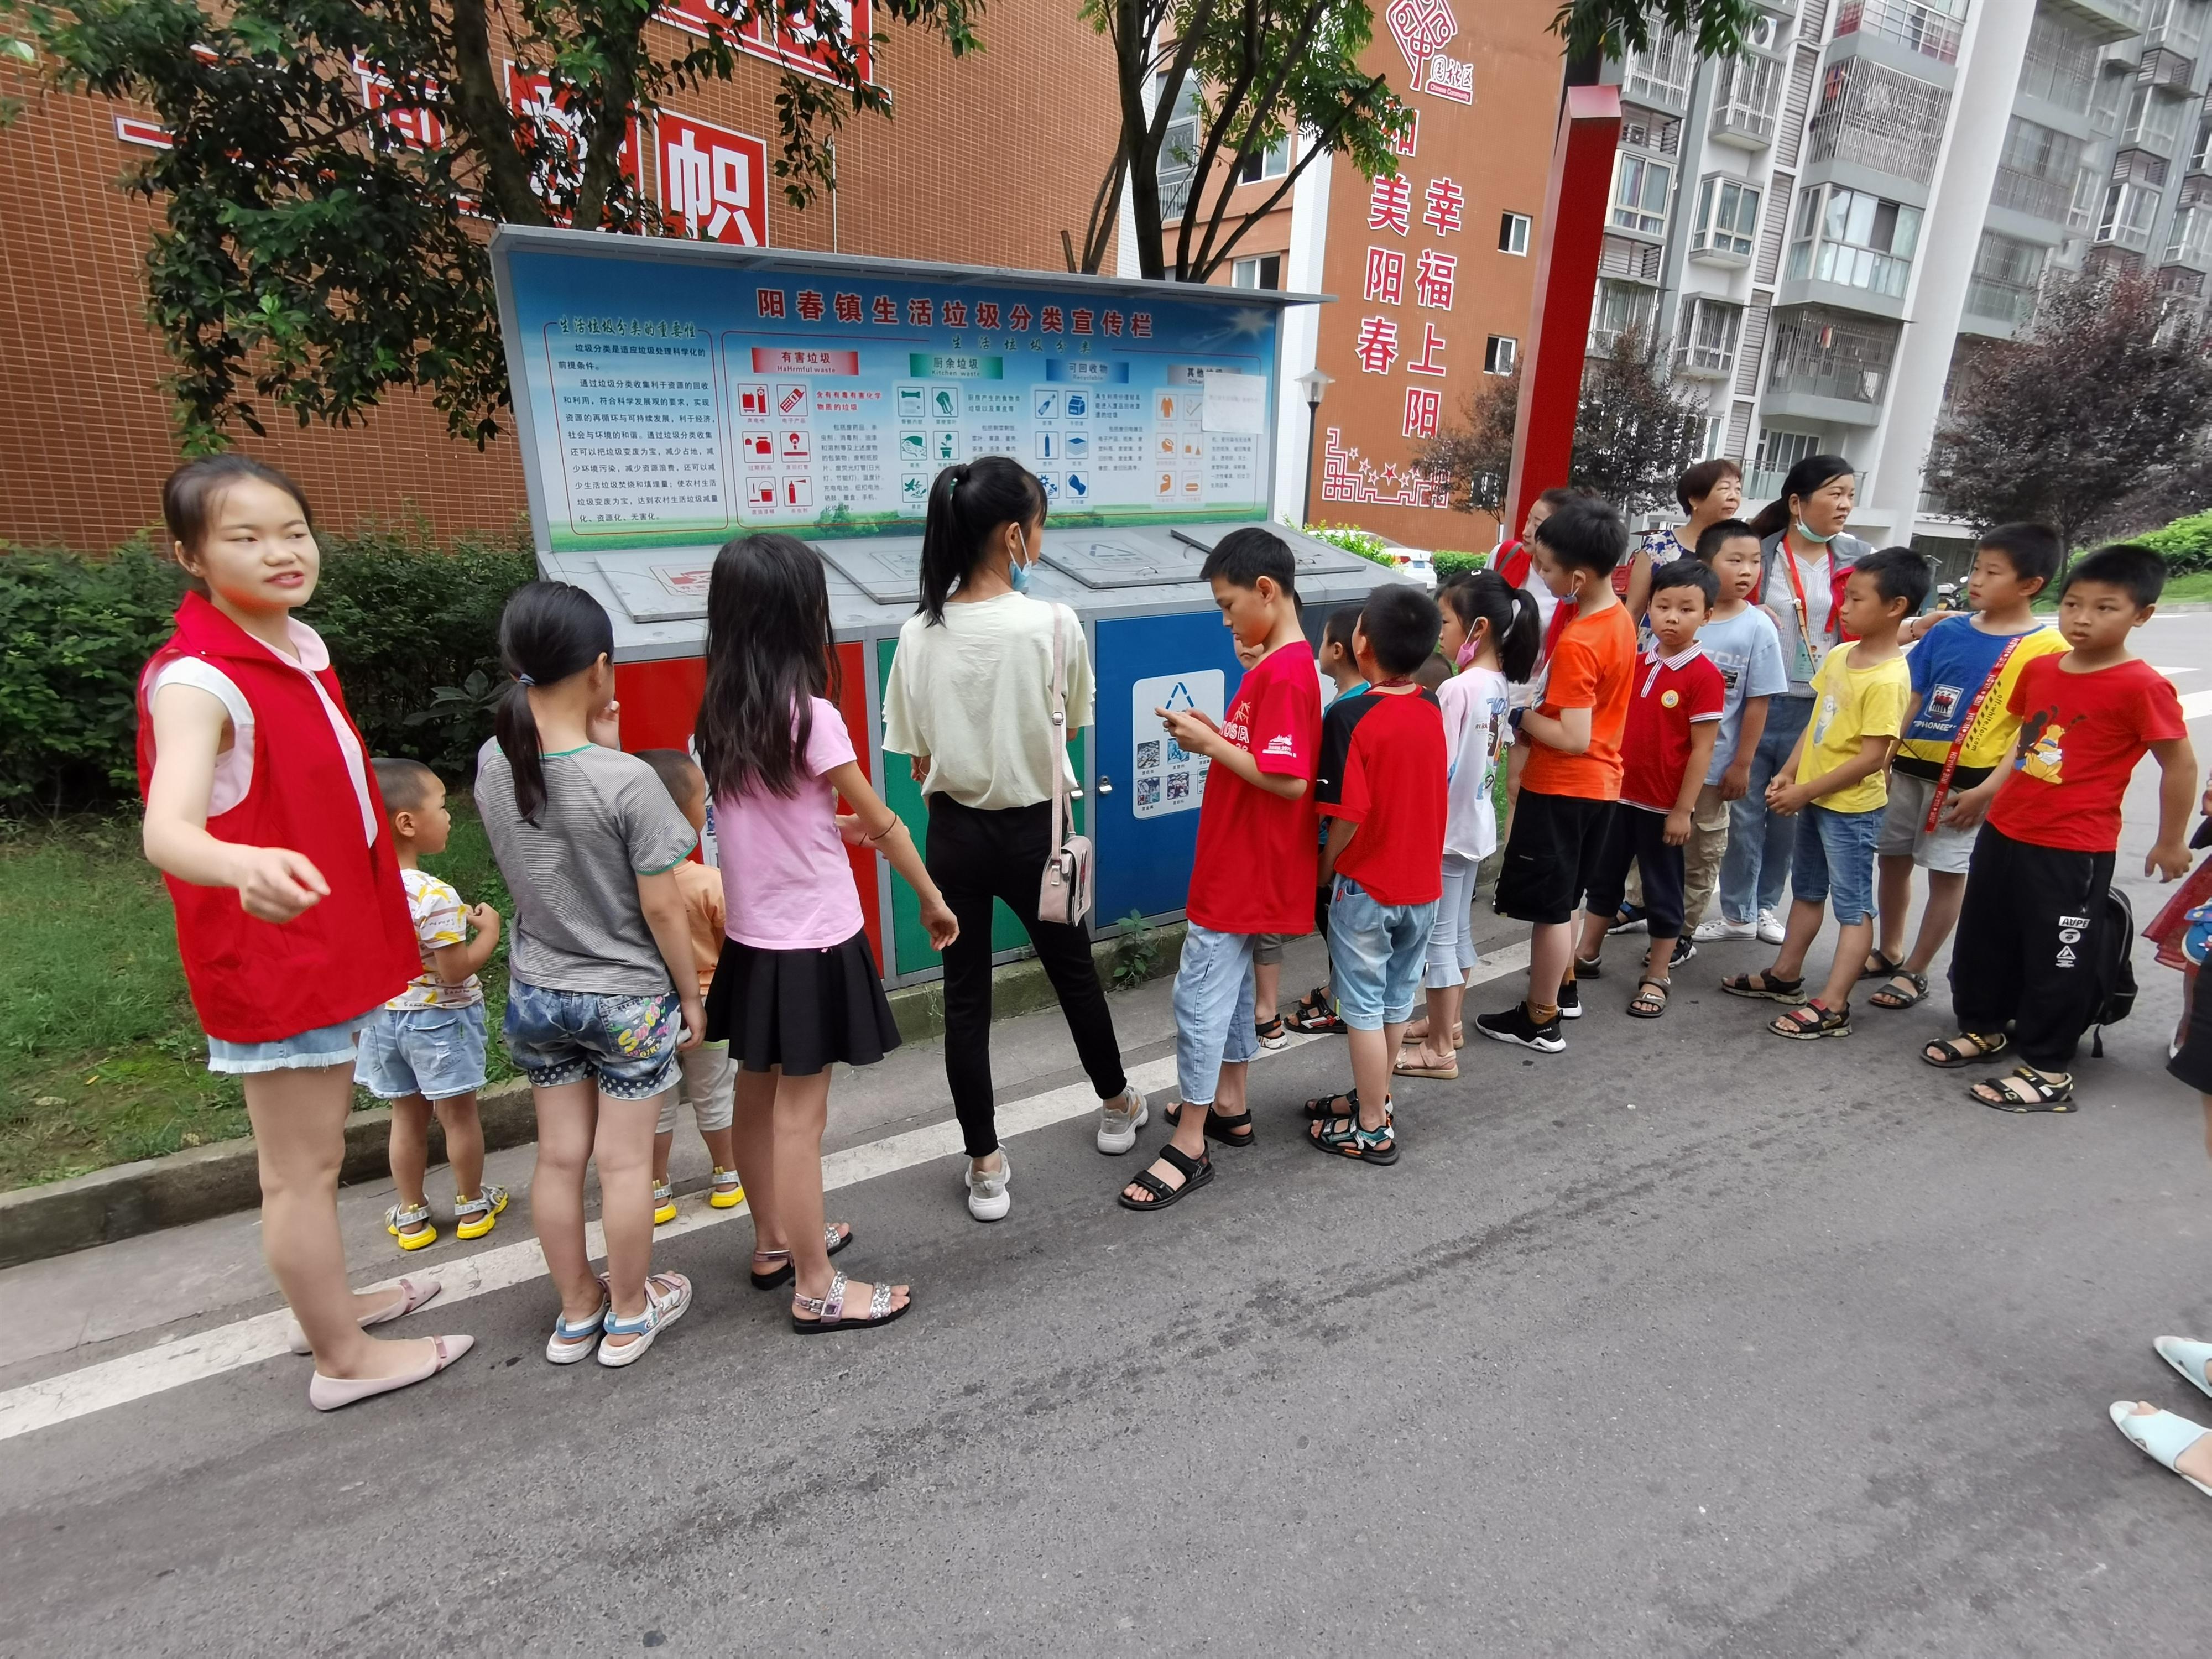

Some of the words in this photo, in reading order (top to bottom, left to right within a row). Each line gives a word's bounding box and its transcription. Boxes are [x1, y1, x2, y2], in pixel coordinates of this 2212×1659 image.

[756, 288, 1153, 338] 阳春镇生活垃圾分类宣传栏
[559, 314, 696, 339] 生活垃圾分类的重要性
[575, 343, 706, 357] 垃圾分类是适应垃圾处理科学化的
[952, 335, 1091, 354] 生活垃圾分类
[781, 351, 831, 363] 有害垃圾
[933, 357, 978, 369] 厨余垃圾
[558, 361, 600, 371] 前提条件。
[1069, 363, 1108, 374] 可回收物
[580, 379, 709, 390] 通过垃圾分类收集利于资源的回收
